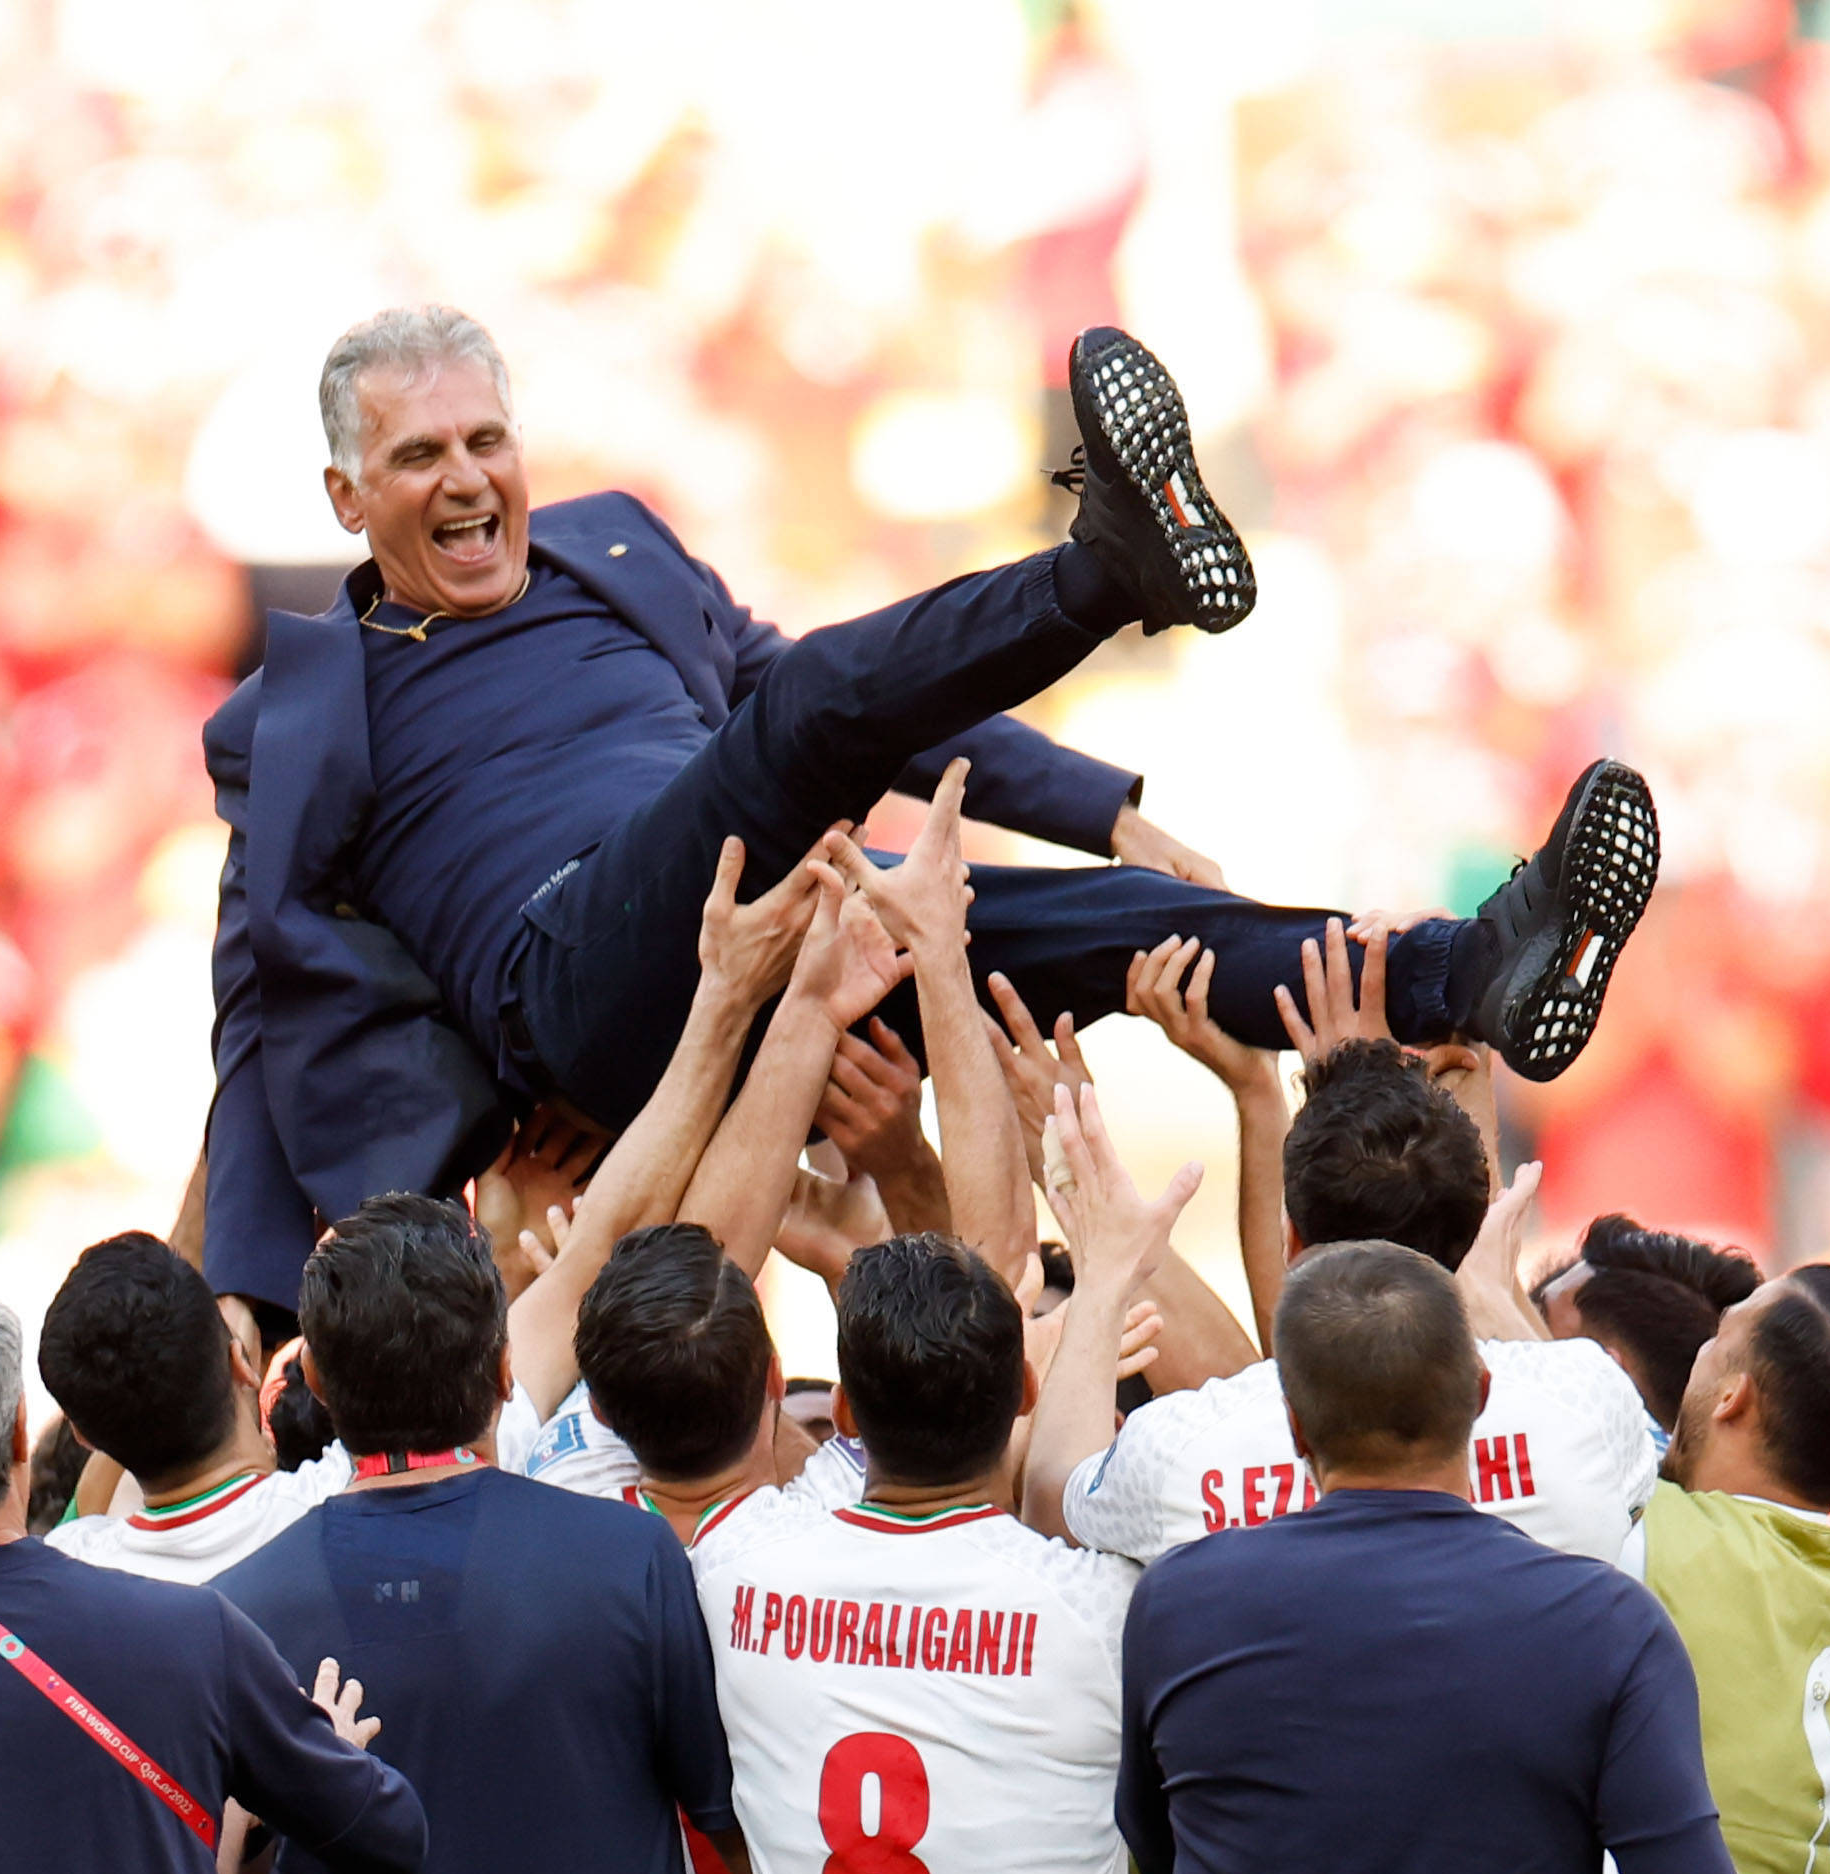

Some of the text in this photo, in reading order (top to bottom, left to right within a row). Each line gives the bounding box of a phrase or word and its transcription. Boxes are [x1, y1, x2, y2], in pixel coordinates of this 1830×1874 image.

[731, 1585, 1038, 1677] M.POURALIGANJI
[64, 1695, 88, 1719] FIFA
[84, 1713, 123, 1749] WORLD
[118, 1744, 141, 1765] CUP
